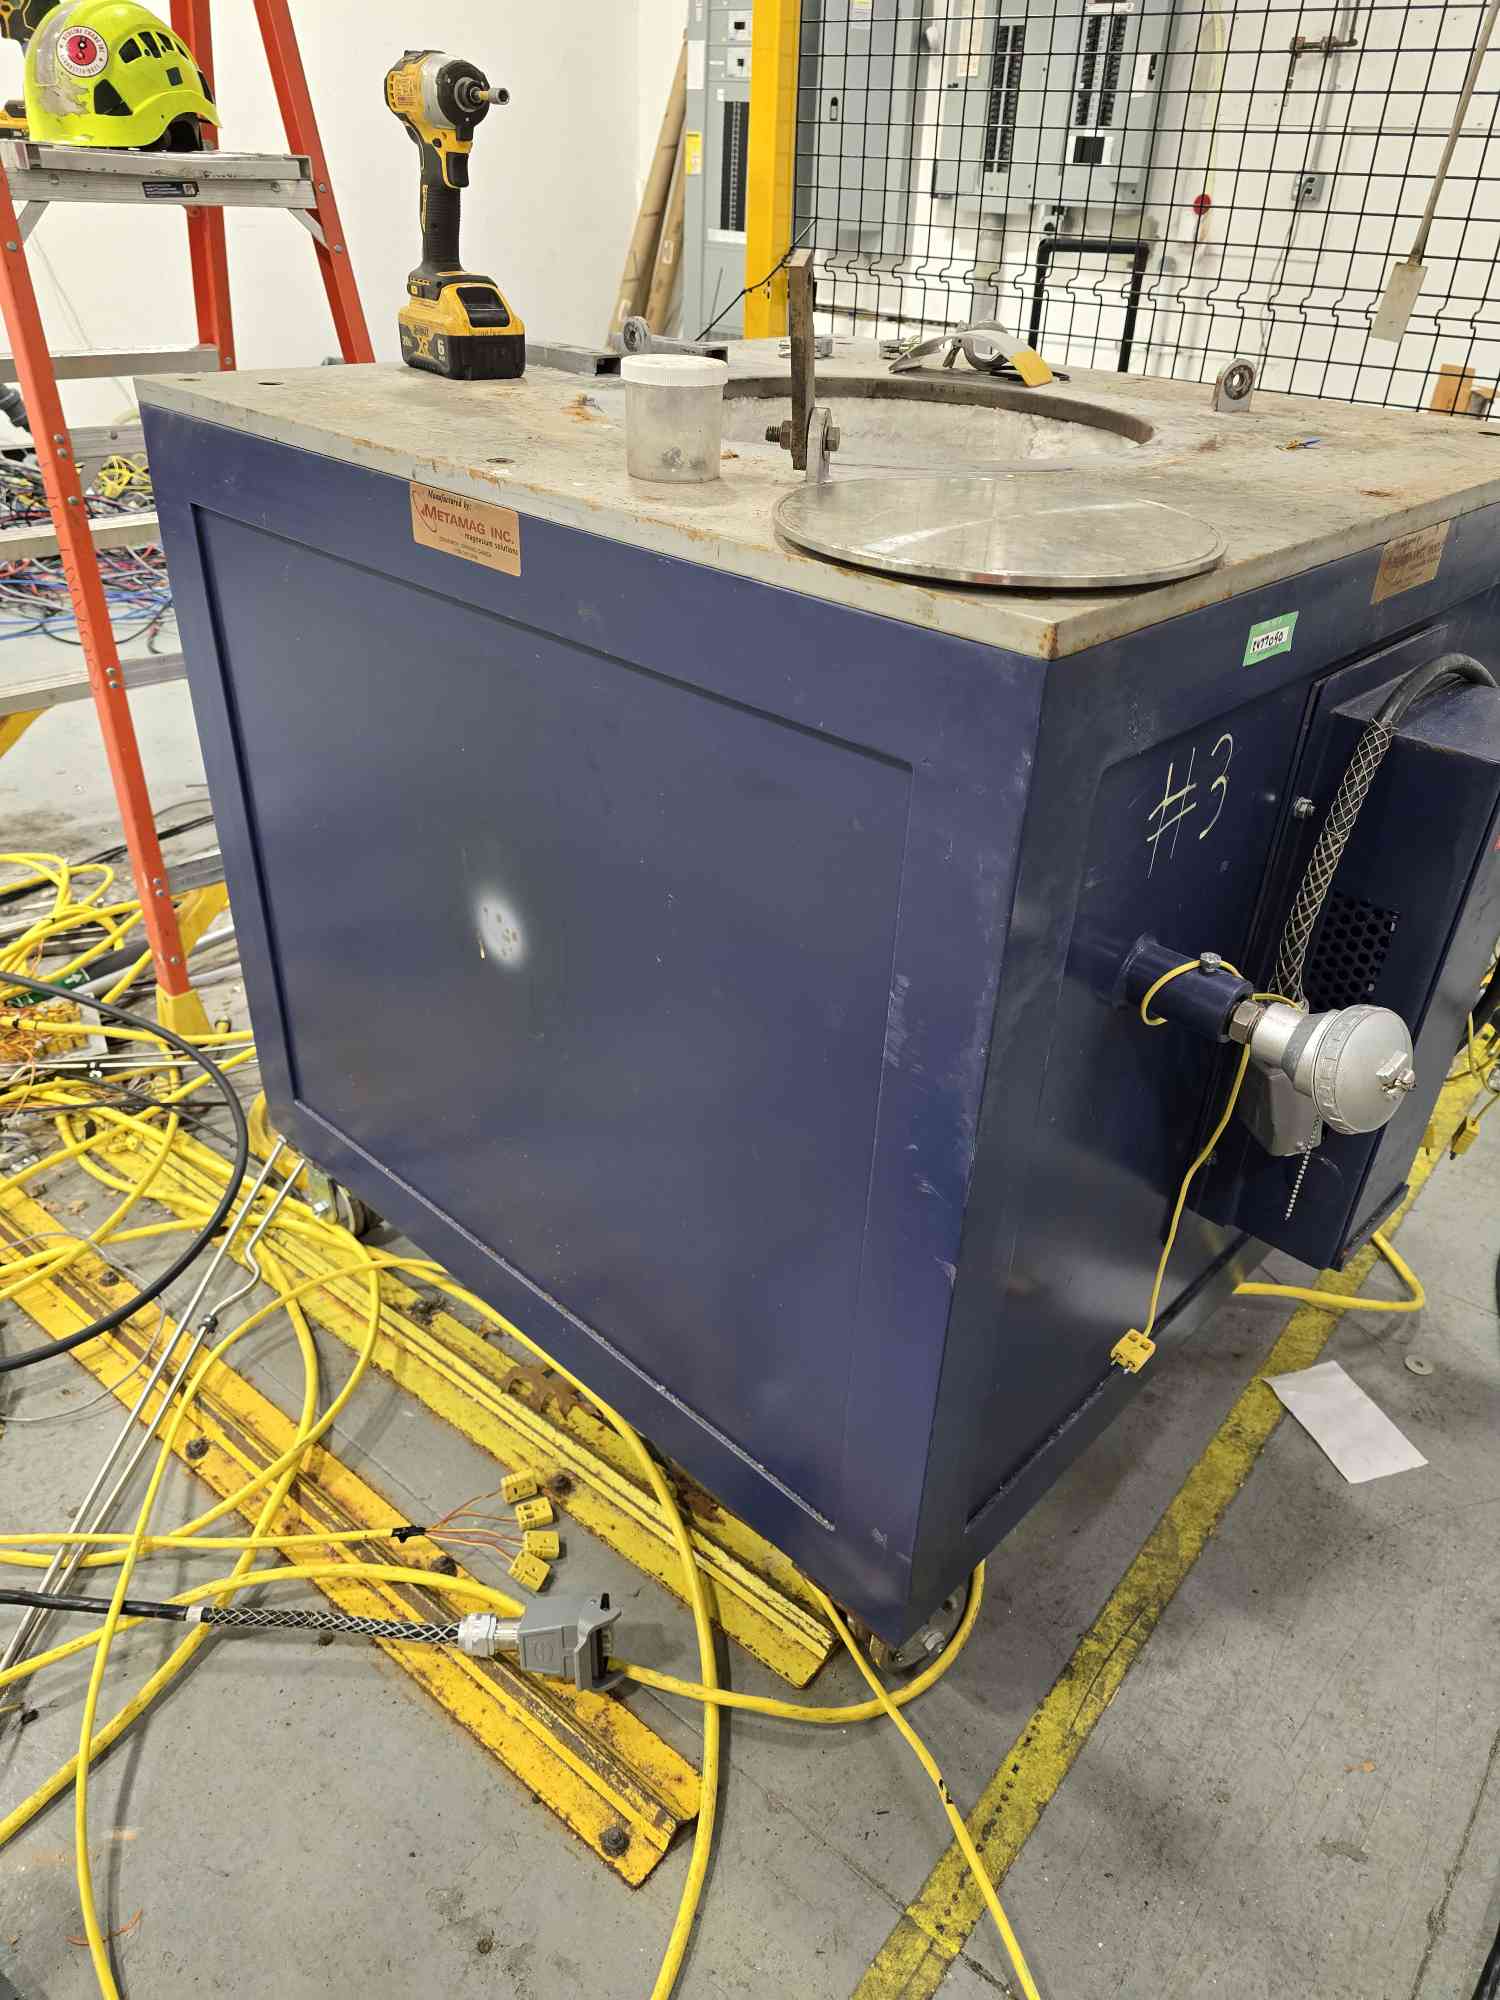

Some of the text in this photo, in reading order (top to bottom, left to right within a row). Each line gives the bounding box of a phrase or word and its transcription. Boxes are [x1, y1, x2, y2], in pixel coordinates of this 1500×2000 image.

[437, 339, 445, 356] 6
[428, 489, 462, 508] Manufactured
[423, 503, 515, 545] METAMAG INC.
[464, 533, 493, 548] magnesium
[1147, 733, 1233, 879] #3
